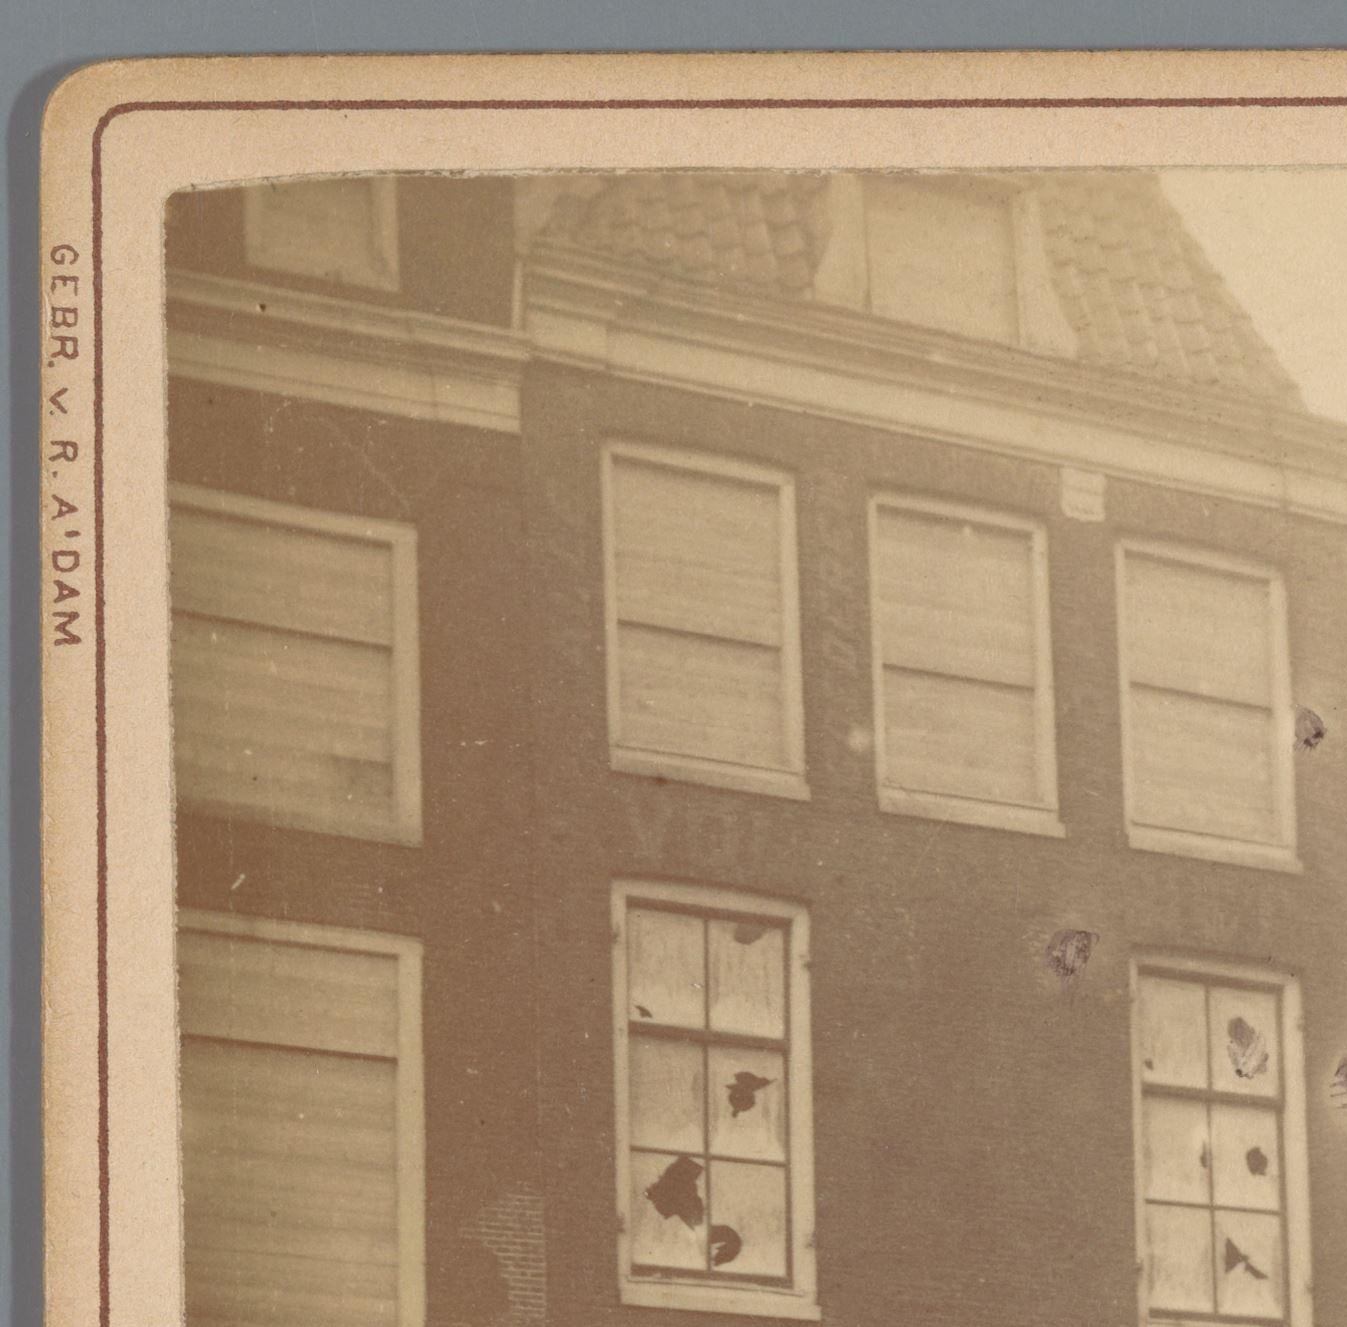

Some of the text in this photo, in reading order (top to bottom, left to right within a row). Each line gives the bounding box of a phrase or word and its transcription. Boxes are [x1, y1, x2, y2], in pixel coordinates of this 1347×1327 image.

[47, 244, 80, 368] GEBR.
[49, 440, 80, 478] R.
[50, 494, 82, 647] A'DAM
